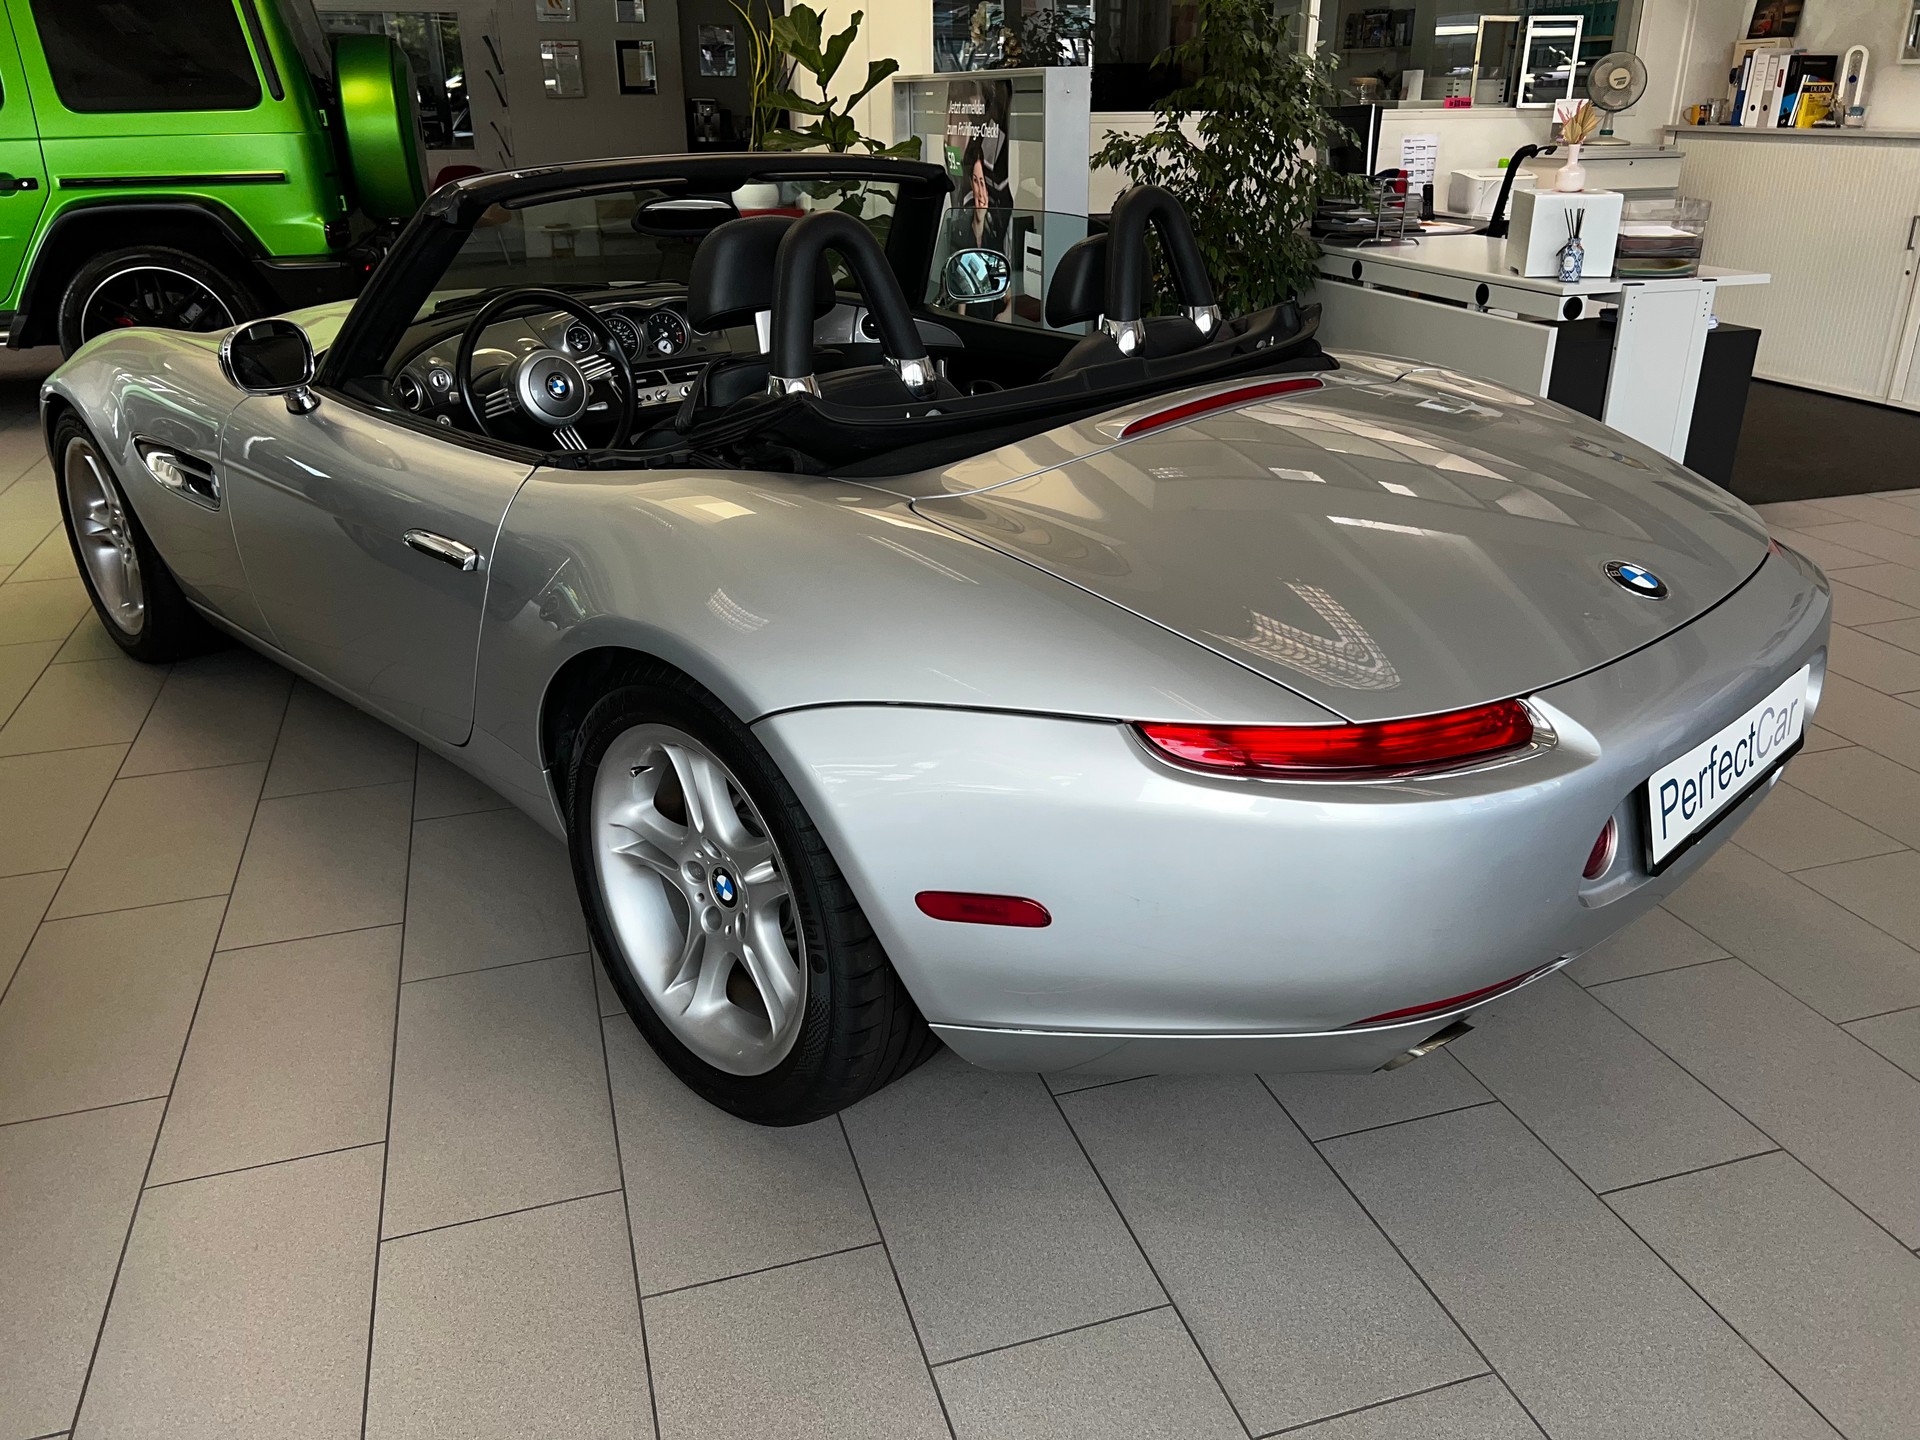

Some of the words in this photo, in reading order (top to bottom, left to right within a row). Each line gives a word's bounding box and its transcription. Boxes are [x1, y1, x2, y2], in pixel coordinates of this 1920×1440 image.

[948, 100, 961, 114] Jetzt
[961, 99, 985, 115] anmelden
[947, 124, 957, 135] zum
[1659, 697, 1799, 841] PerfectCar
